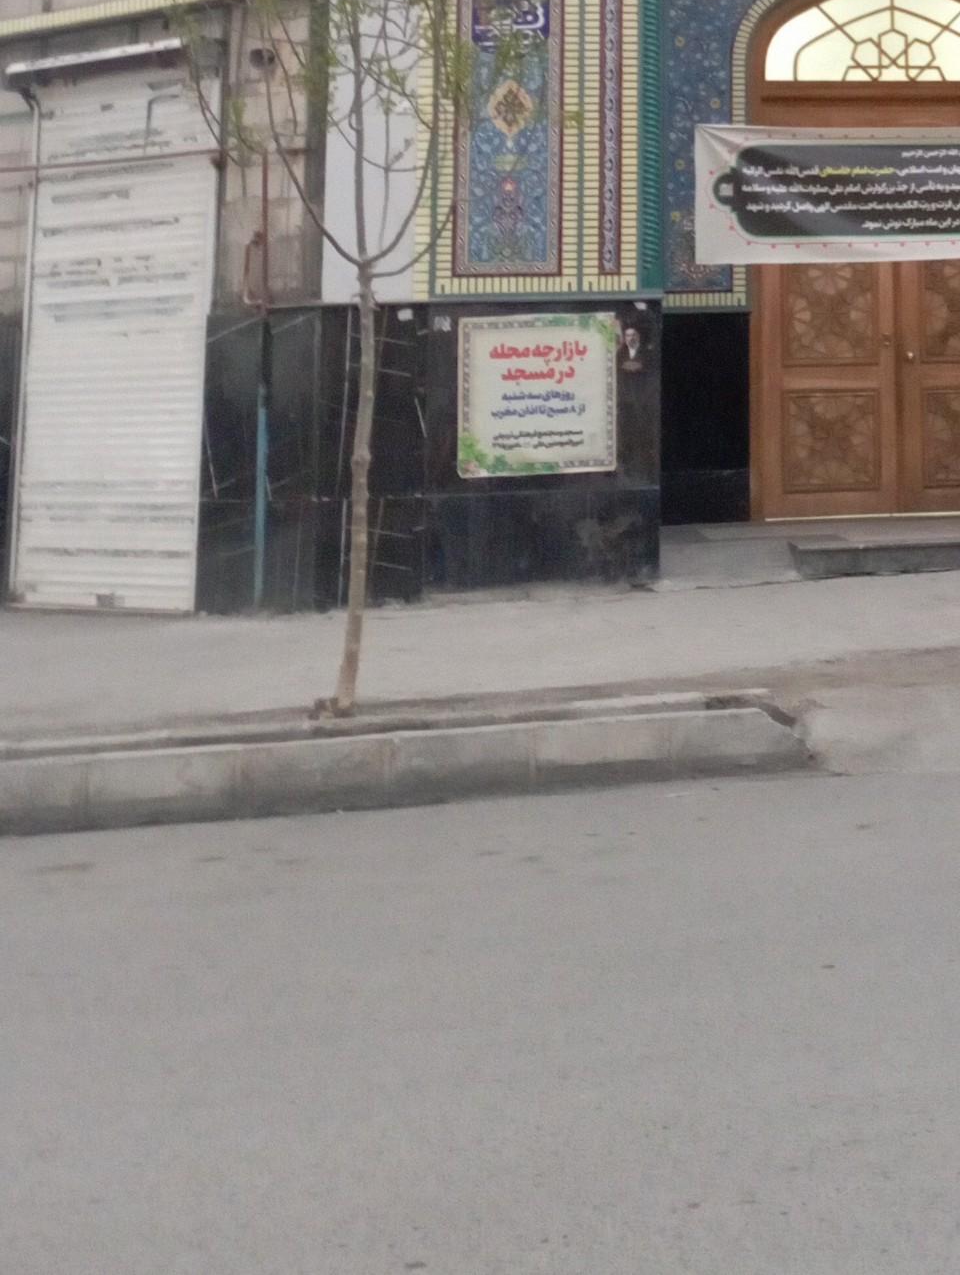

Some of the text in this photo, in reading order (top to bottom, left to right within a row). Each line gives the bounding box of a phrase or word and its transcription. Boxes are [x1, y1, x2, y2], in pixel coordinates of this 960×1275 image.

[489, 340, 588, 367] بازارچه محله
[501, 365, 576, 387] در مسجد
